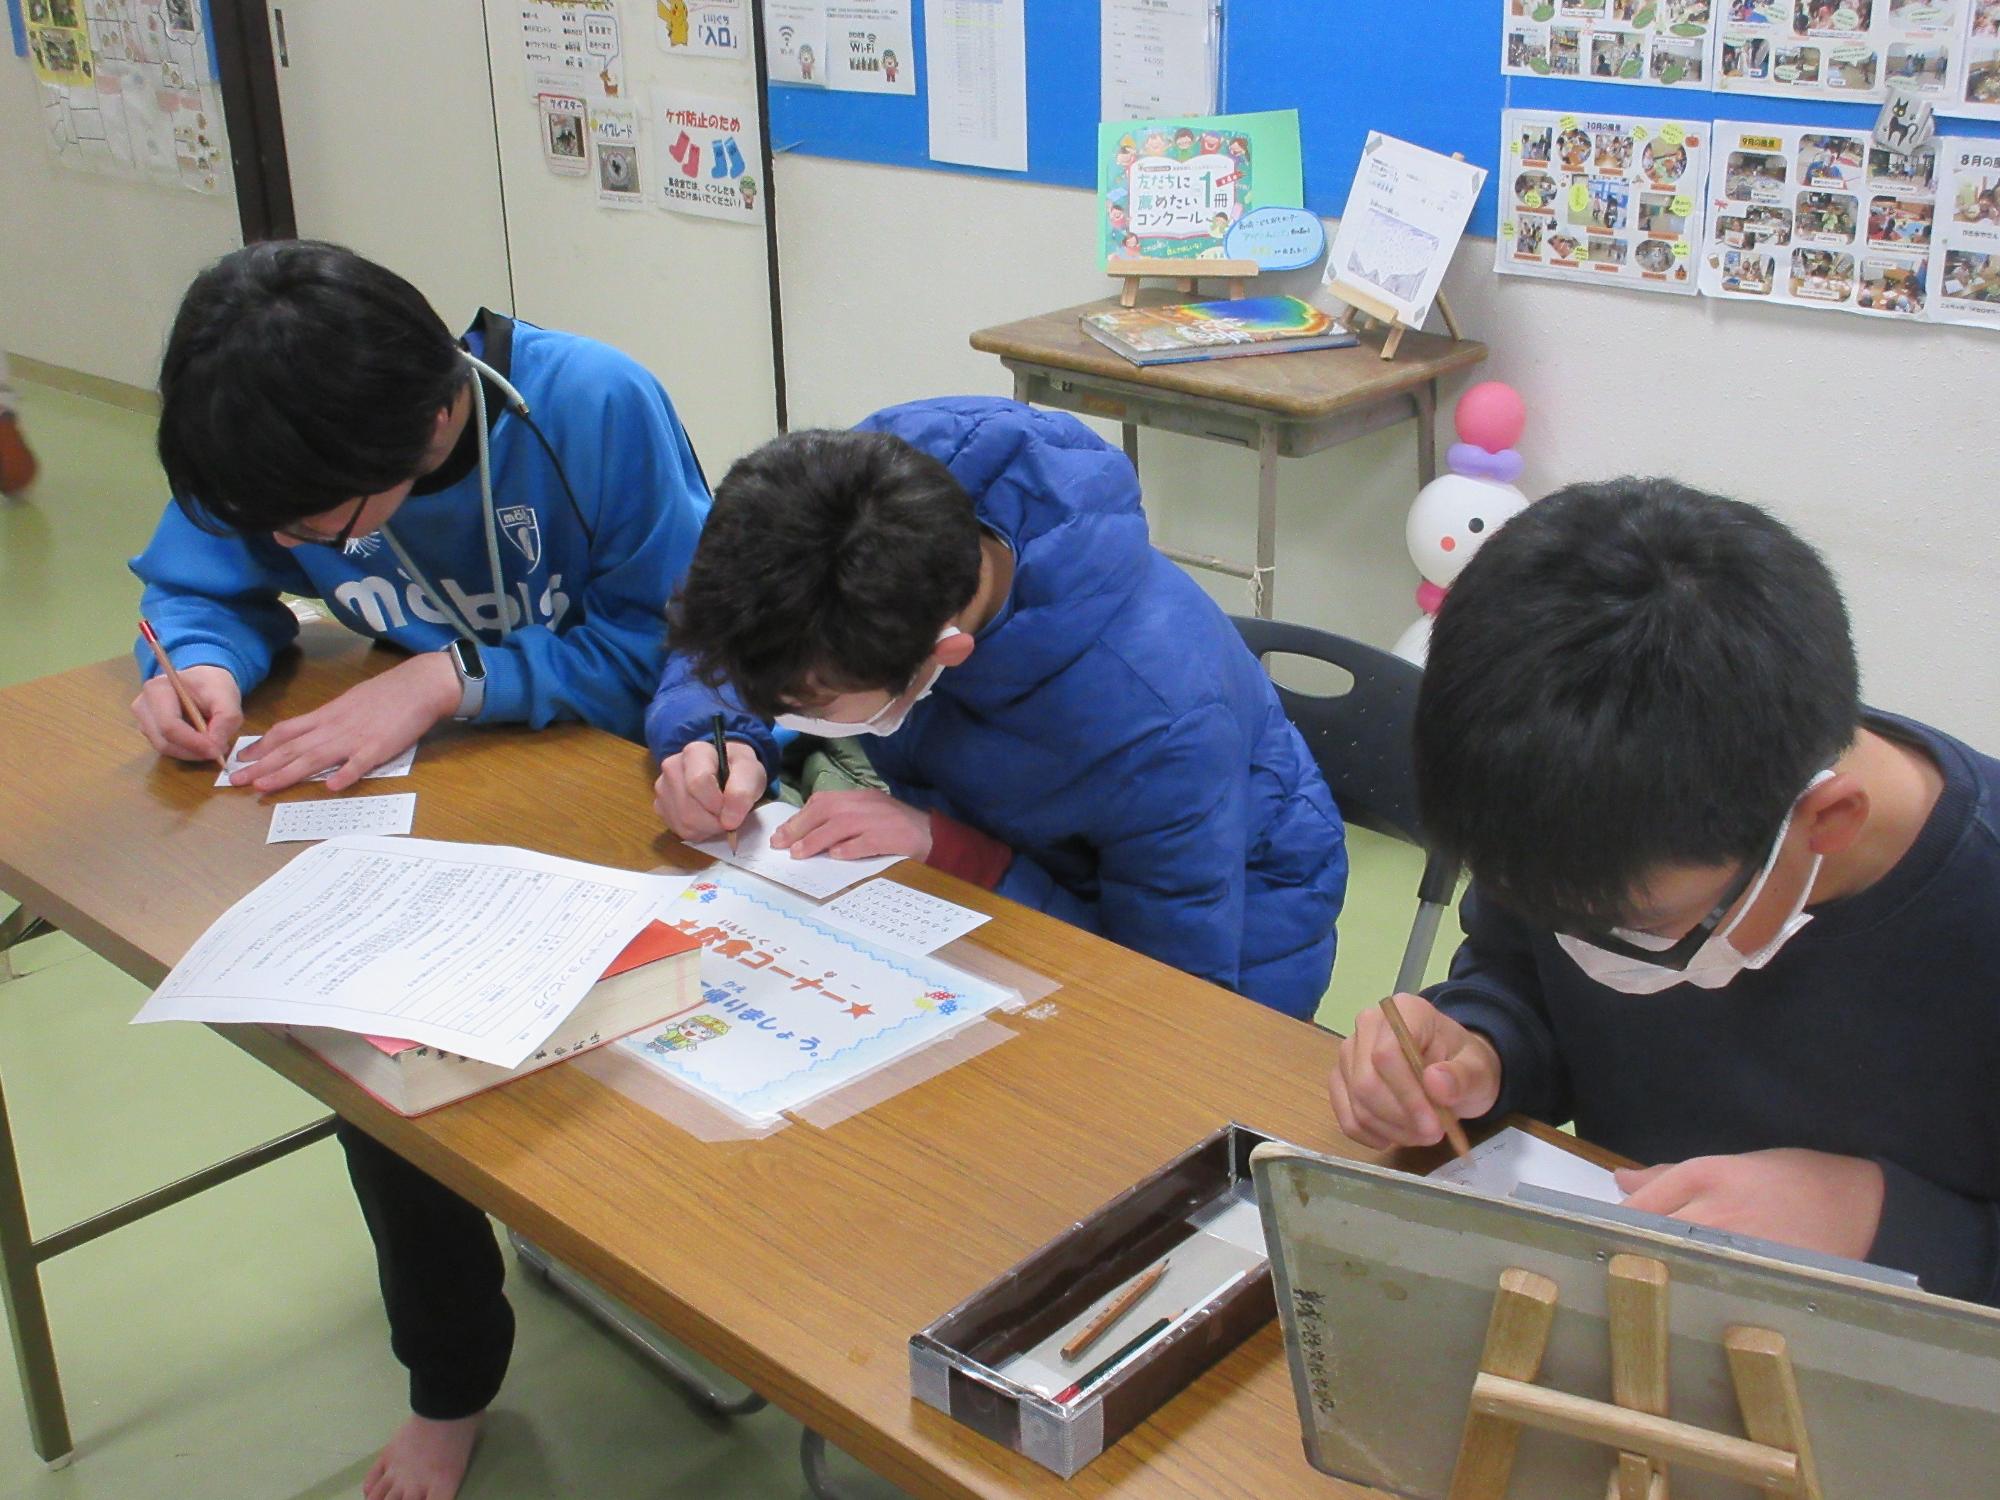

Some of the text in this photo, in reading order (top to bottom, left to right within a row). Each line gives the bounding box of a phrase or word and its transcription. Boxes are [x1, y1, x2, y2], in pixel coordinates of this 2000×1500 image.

[698, 25, 738, 48] 「入口」
[849, 41, 876, 54] Wi-Fi
[665, 108, 742, 133] ケガ防止のため
[1137, 174, 1191, 190] 友だちに
[1137, 211, 1204, 227] コンクール
[721, 980, 747, 994] かえ
